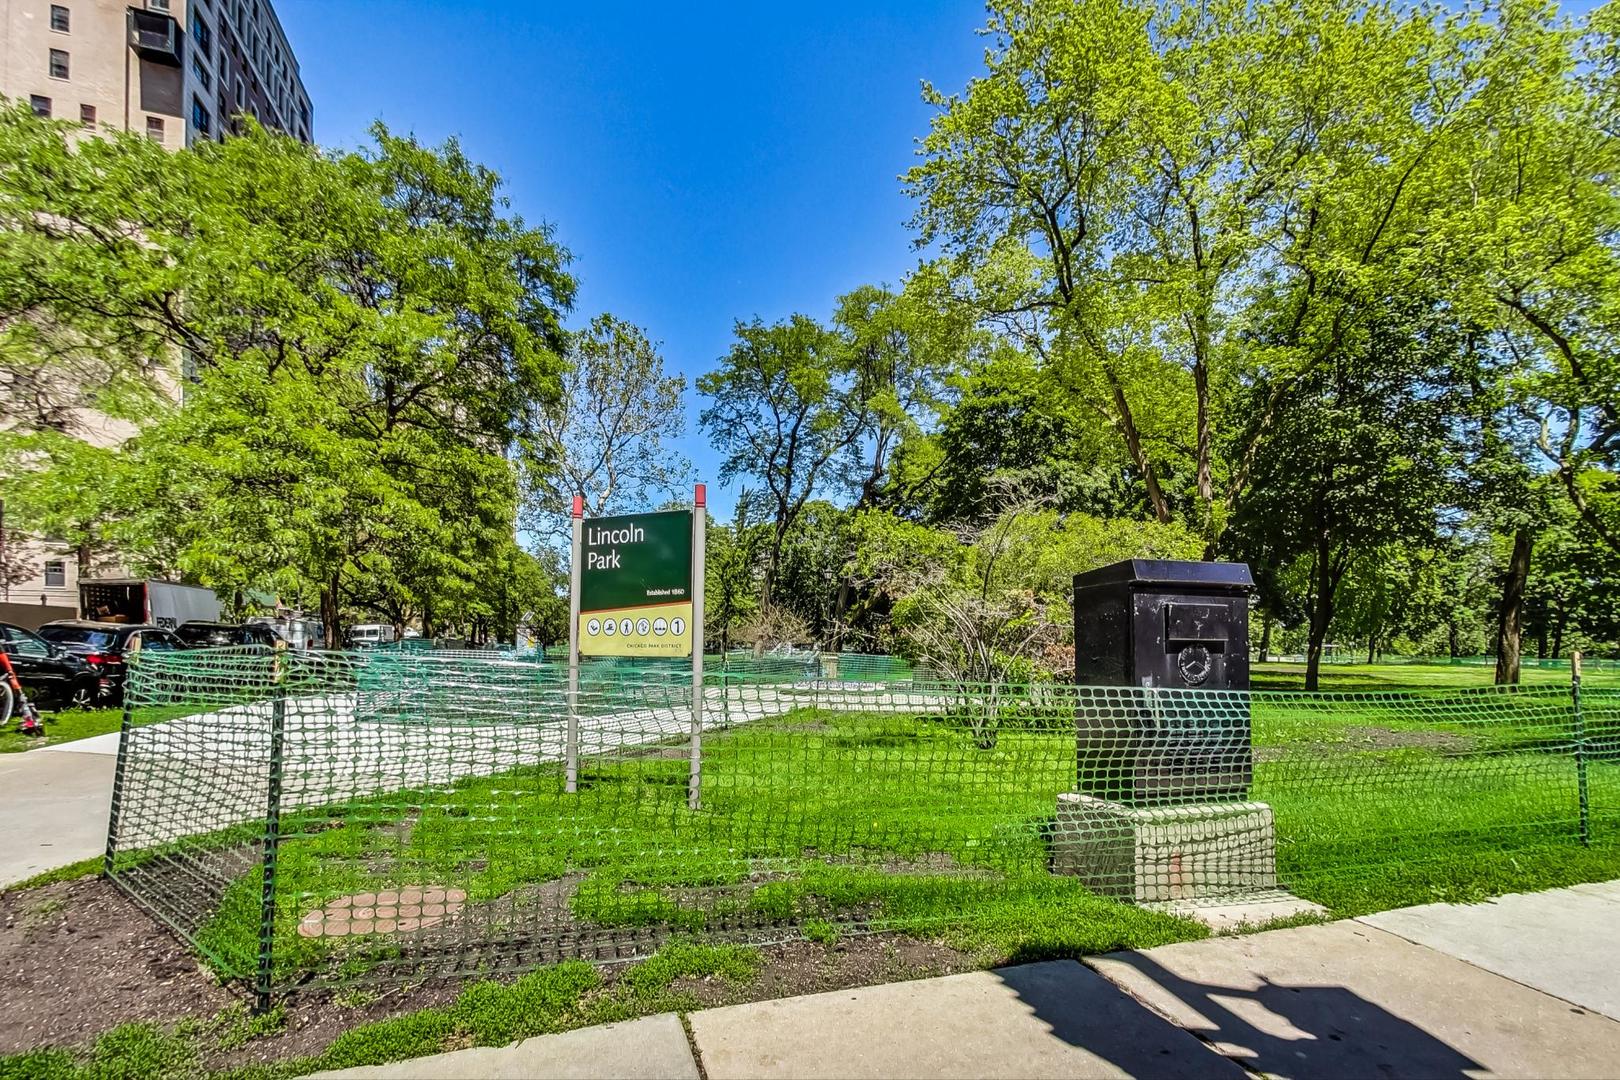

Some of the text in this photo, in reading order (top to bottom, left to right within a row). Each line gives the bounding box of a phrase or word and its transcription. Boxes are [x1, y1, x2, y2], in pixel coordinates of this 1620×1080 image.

[588, 522, 644, 546] Lincoln
[587, 548, 621, 570] Park
[646, 588, 671, 596] Established
